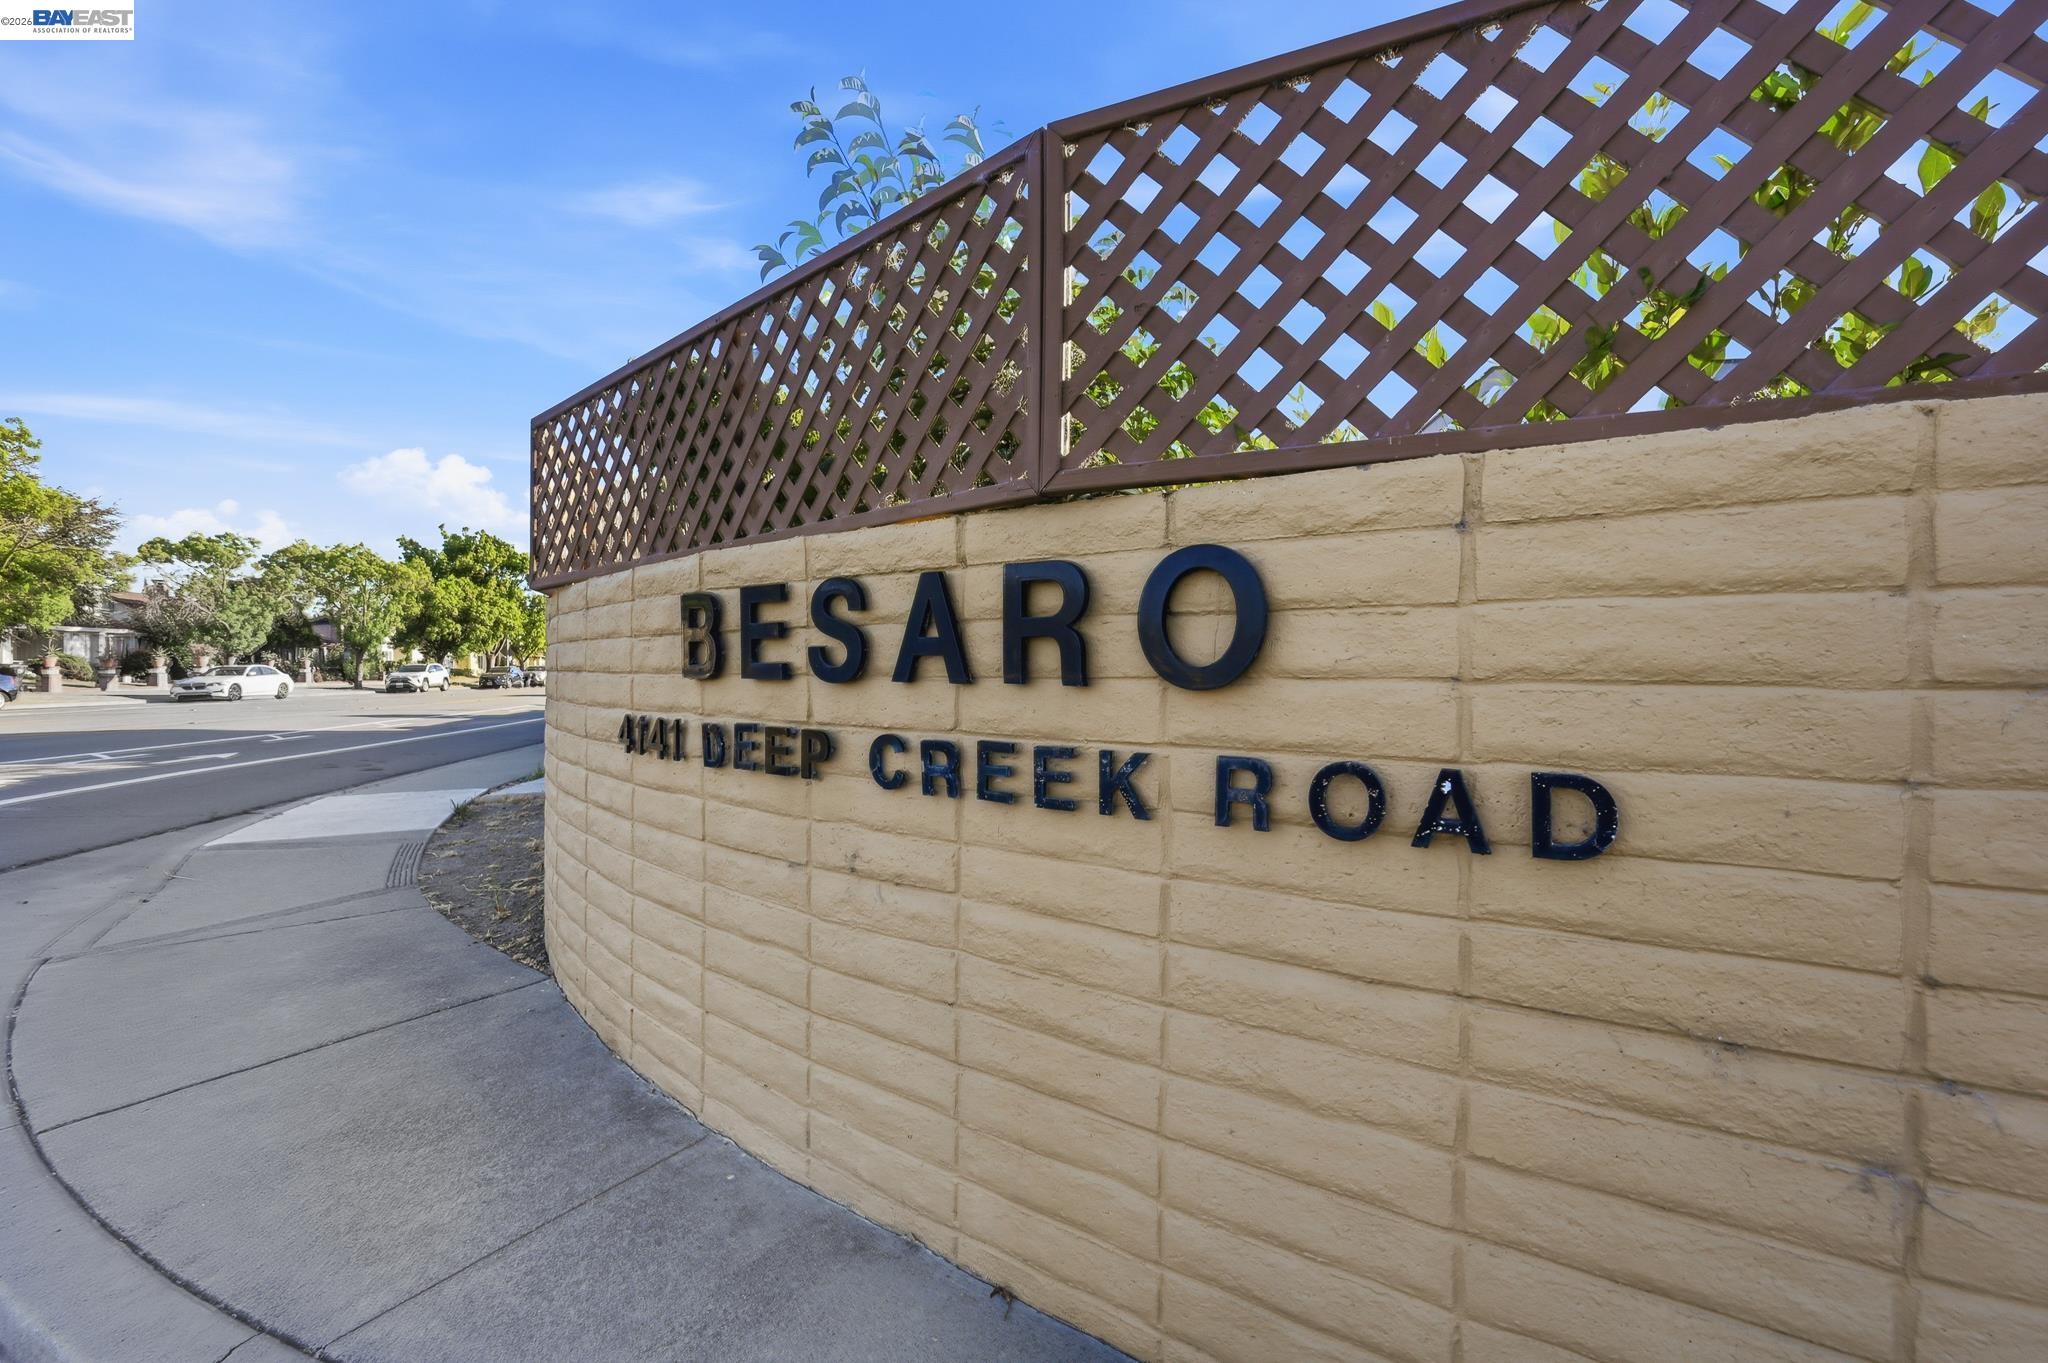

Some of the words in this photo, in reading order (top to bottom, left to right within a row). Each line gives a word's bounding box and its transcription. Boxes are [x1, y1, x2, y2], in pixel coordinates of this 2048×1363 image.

[680, 544, 1268, 690] BESARO
[618, 713, 685, 761] 4141
[702, 722, 832, 779] DEEP
[868, 734, 1153, 821] CREEK
[1214, 755, 1620, 861] ROAD
